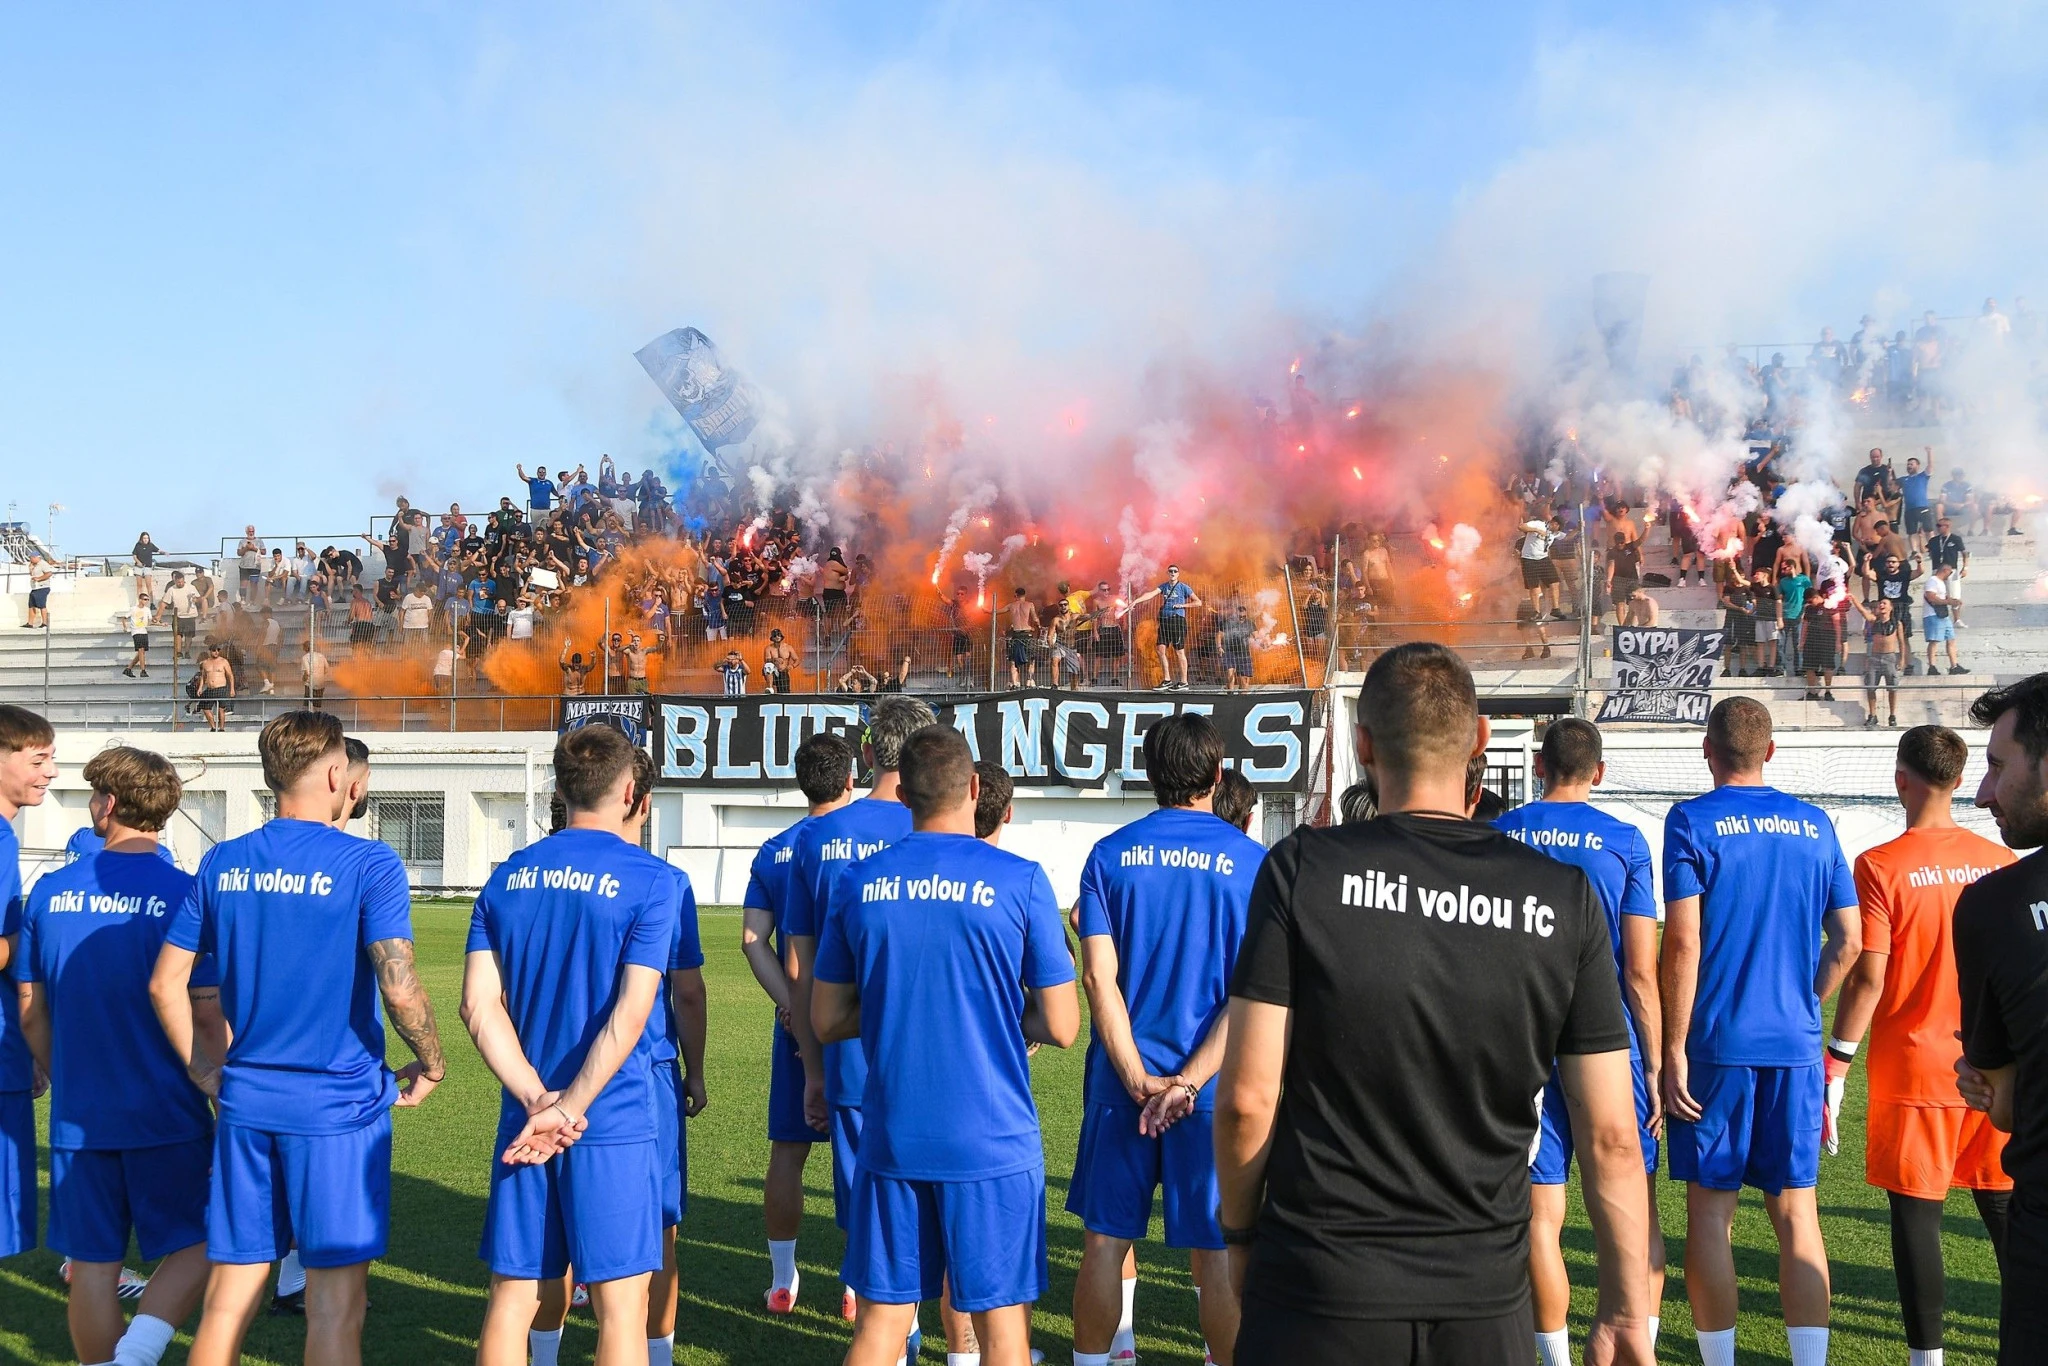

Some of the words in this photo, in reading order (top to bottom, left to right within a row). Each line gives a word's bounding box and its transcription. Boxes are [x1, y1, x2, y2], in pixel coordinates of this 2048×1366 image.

[1618, 631, 1680, 655] ΘΥΡΑ
[1684, 664, 1713, 692] 24
[1676, 693, 1708, 721] ΚΗ
[1531, 828, 1580, 847] volou
[1584, 832, 1603, 851] fc
[1715, 814, 1751, 836] niki
[1753, 814, 1801, 836] volou
[1803, 819, 1819, 839] fc
[821, 838, 853, 861] niki
[1121, 846, 1154, 867] niki
[1159, 846, 1211, 870] volou
[1215, 852, 1234, 876] fc
[218, 867, 250, 892] niki
[254, 868, 305, 894] volou
[310, 871, 333, 896] fc
[506, 866, 539, 891] niki
[543, 865, 595, 892] volou
[597, 873, 620, 899] fc
[1909, 865, 1944, 887] niki
[49, 890, 85, 914] niki
[89, 892, 141, 914] volou
[146, 895, 166, 918] fc
[862, 875, 901, 903] niki
[906, 874, 967, 902] volou
[971, 880, 995, 908] fc
[1341, 869, 1408, 913] niki
[1417, 884, 1513, 930] volou
[1522, 895, 1555, 938] fc
